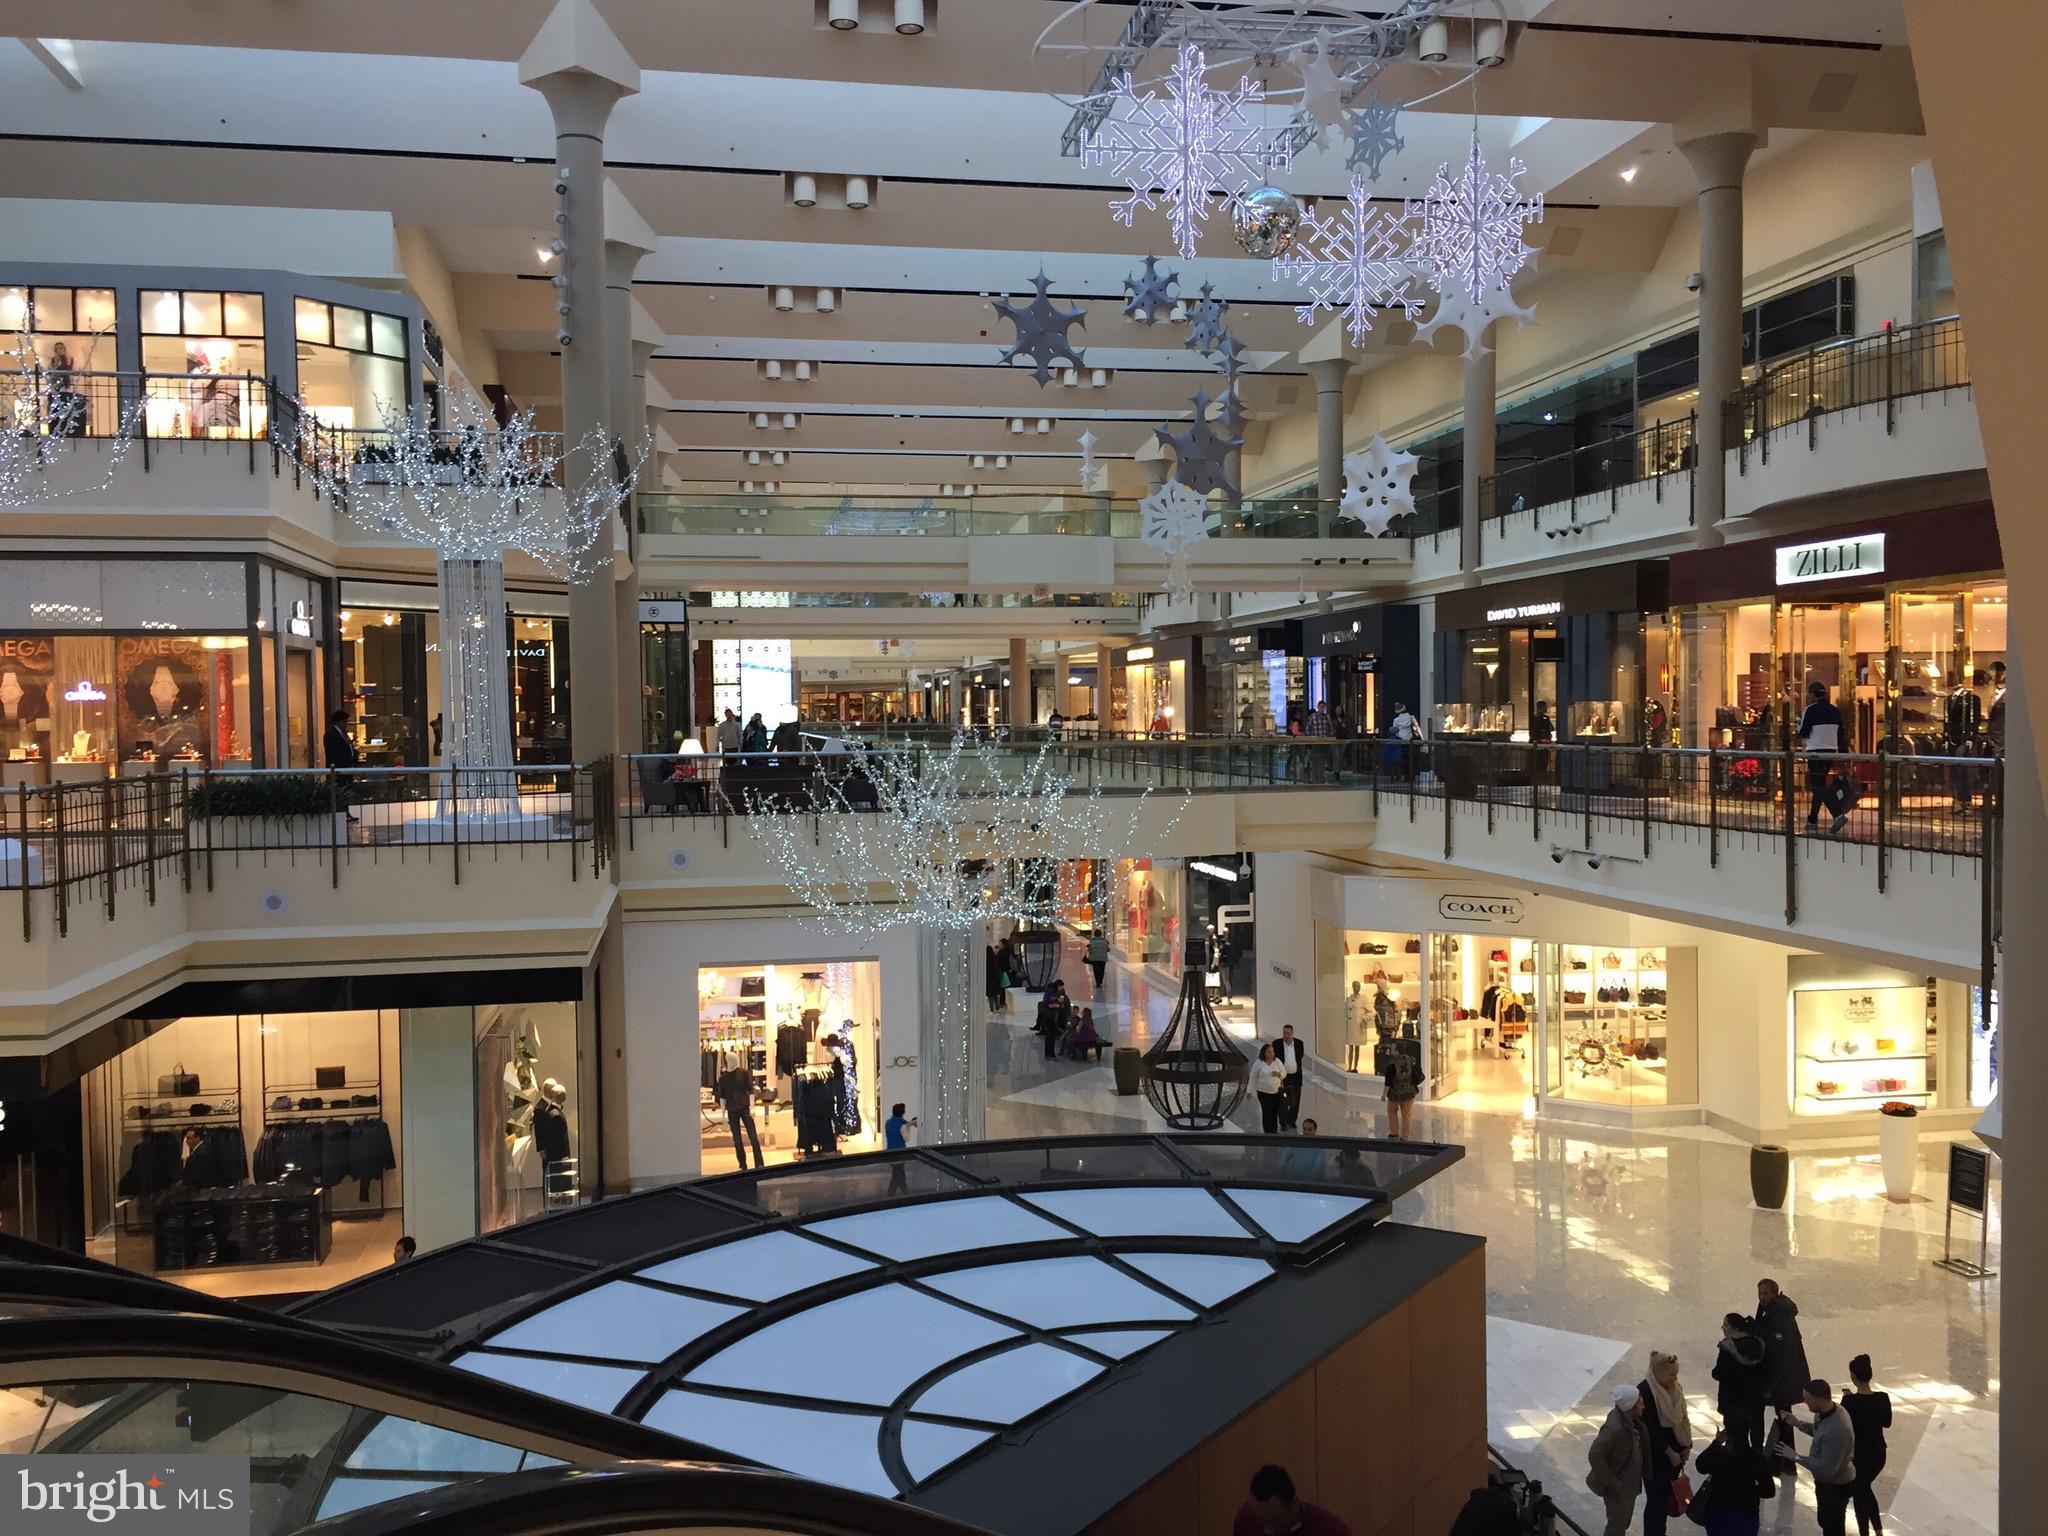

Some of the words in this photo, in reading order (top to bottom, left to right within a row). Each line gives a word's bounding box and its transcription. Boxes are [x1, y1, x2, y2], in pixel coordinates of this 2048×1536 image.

[1796, 542, 1862, 577] ZILLI
[1487, 608, 1516, 621] DAVID
[0, 640, 52, 657] EGA
[120, 638, 202, 655] OMEGA
[1447, 902, 1515, 915] COACH
[886, 1056, 918, 1068] JOE
